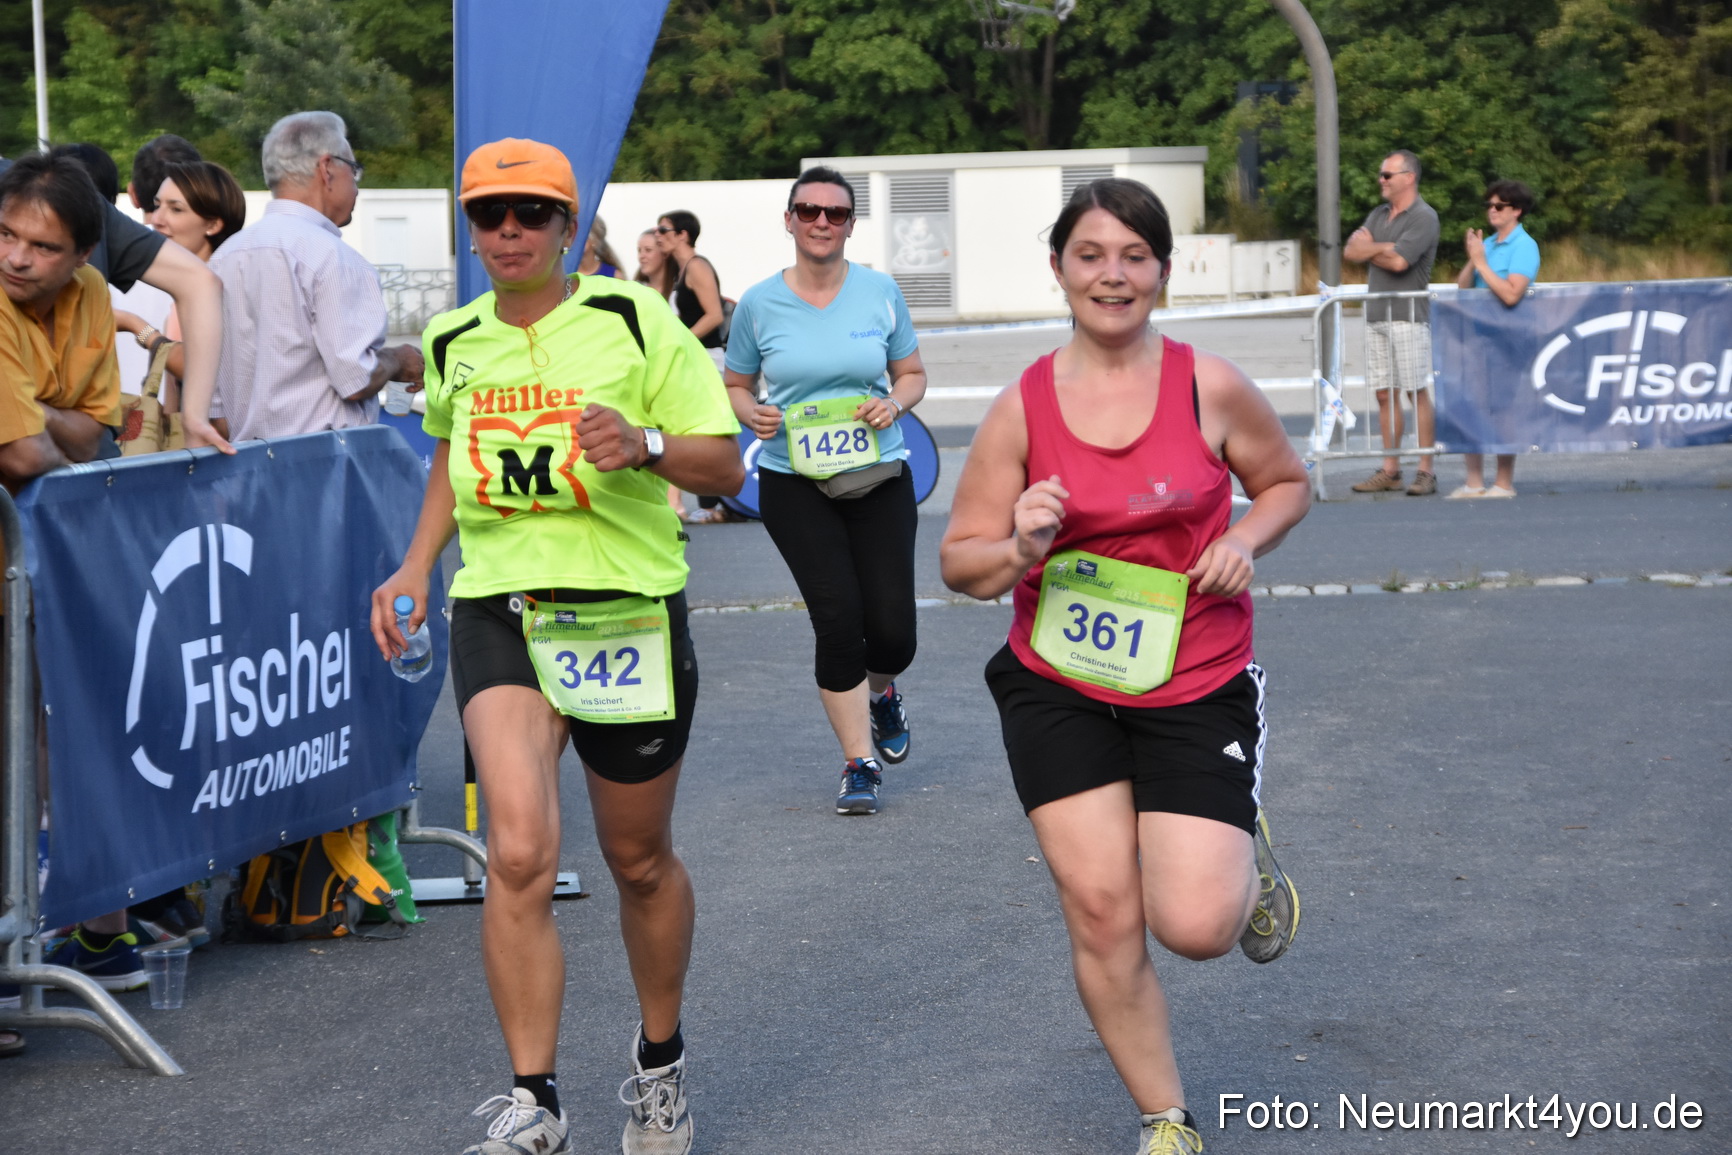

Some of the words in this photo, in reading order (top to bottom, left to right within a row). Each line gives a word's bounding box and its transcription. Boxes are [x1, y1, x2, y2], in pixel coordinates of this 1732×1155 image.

[470, 383, 584, 415] Müller
[798, 427, 869, 459] 1428
[496, 445, 559, 496] M
[1065, 569, 1114, 590] firmenlauf
[1112, 588, 1140, 601] 2015
[545, 621, 596, 633] firmenlauf
[598, 624, 624, 635] 2015
[1063, 602, 1144, 658] 361
[555, 646, 641, 689] 342
[1070, 651, 1107, 668] Christine
[1107, 662, 1128, 674] Heid
[580, 698, 593, 706] Iris
[593, 697, 623, 706] Sichert
[191, 725, 350, 814] AUTOMOBILE
